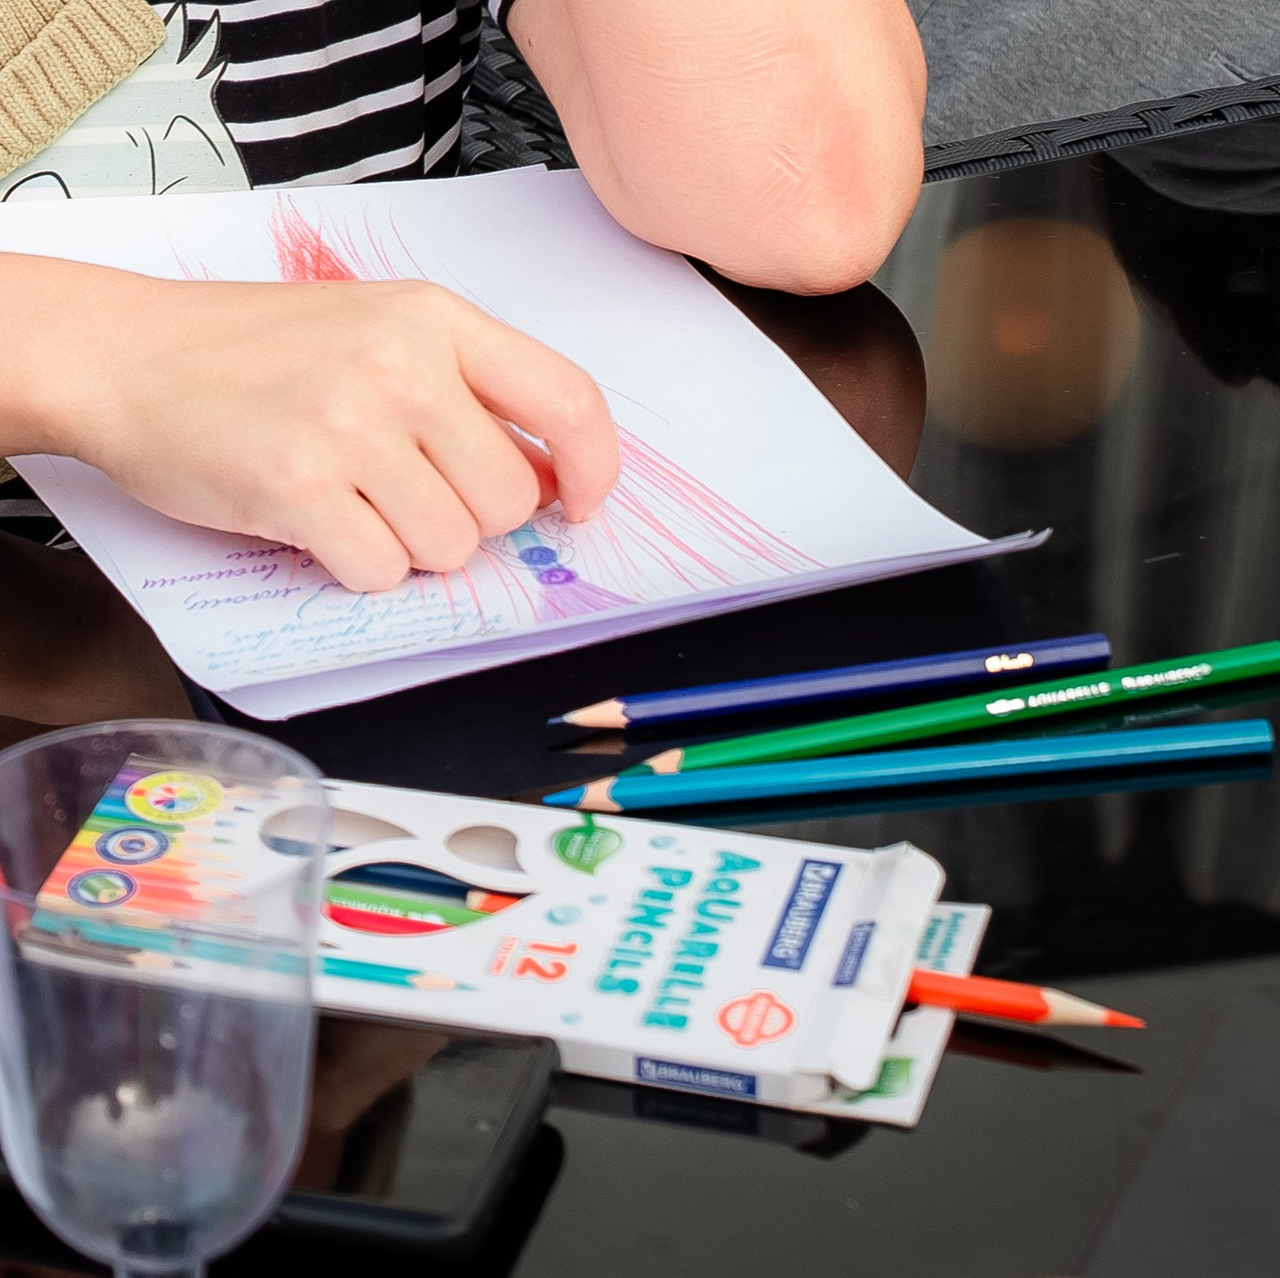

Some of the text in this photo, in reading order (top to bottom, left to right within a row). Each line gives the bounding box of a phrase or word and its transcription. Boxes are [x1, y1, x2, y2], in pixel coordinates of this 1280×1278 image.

[517, 942, 578, 980] 12
[596, 867, 694, 994] PENCILS
[642, 849, 762, 1030] AQUARELLE
[770, 867, 831, 962] BRAUBERG
